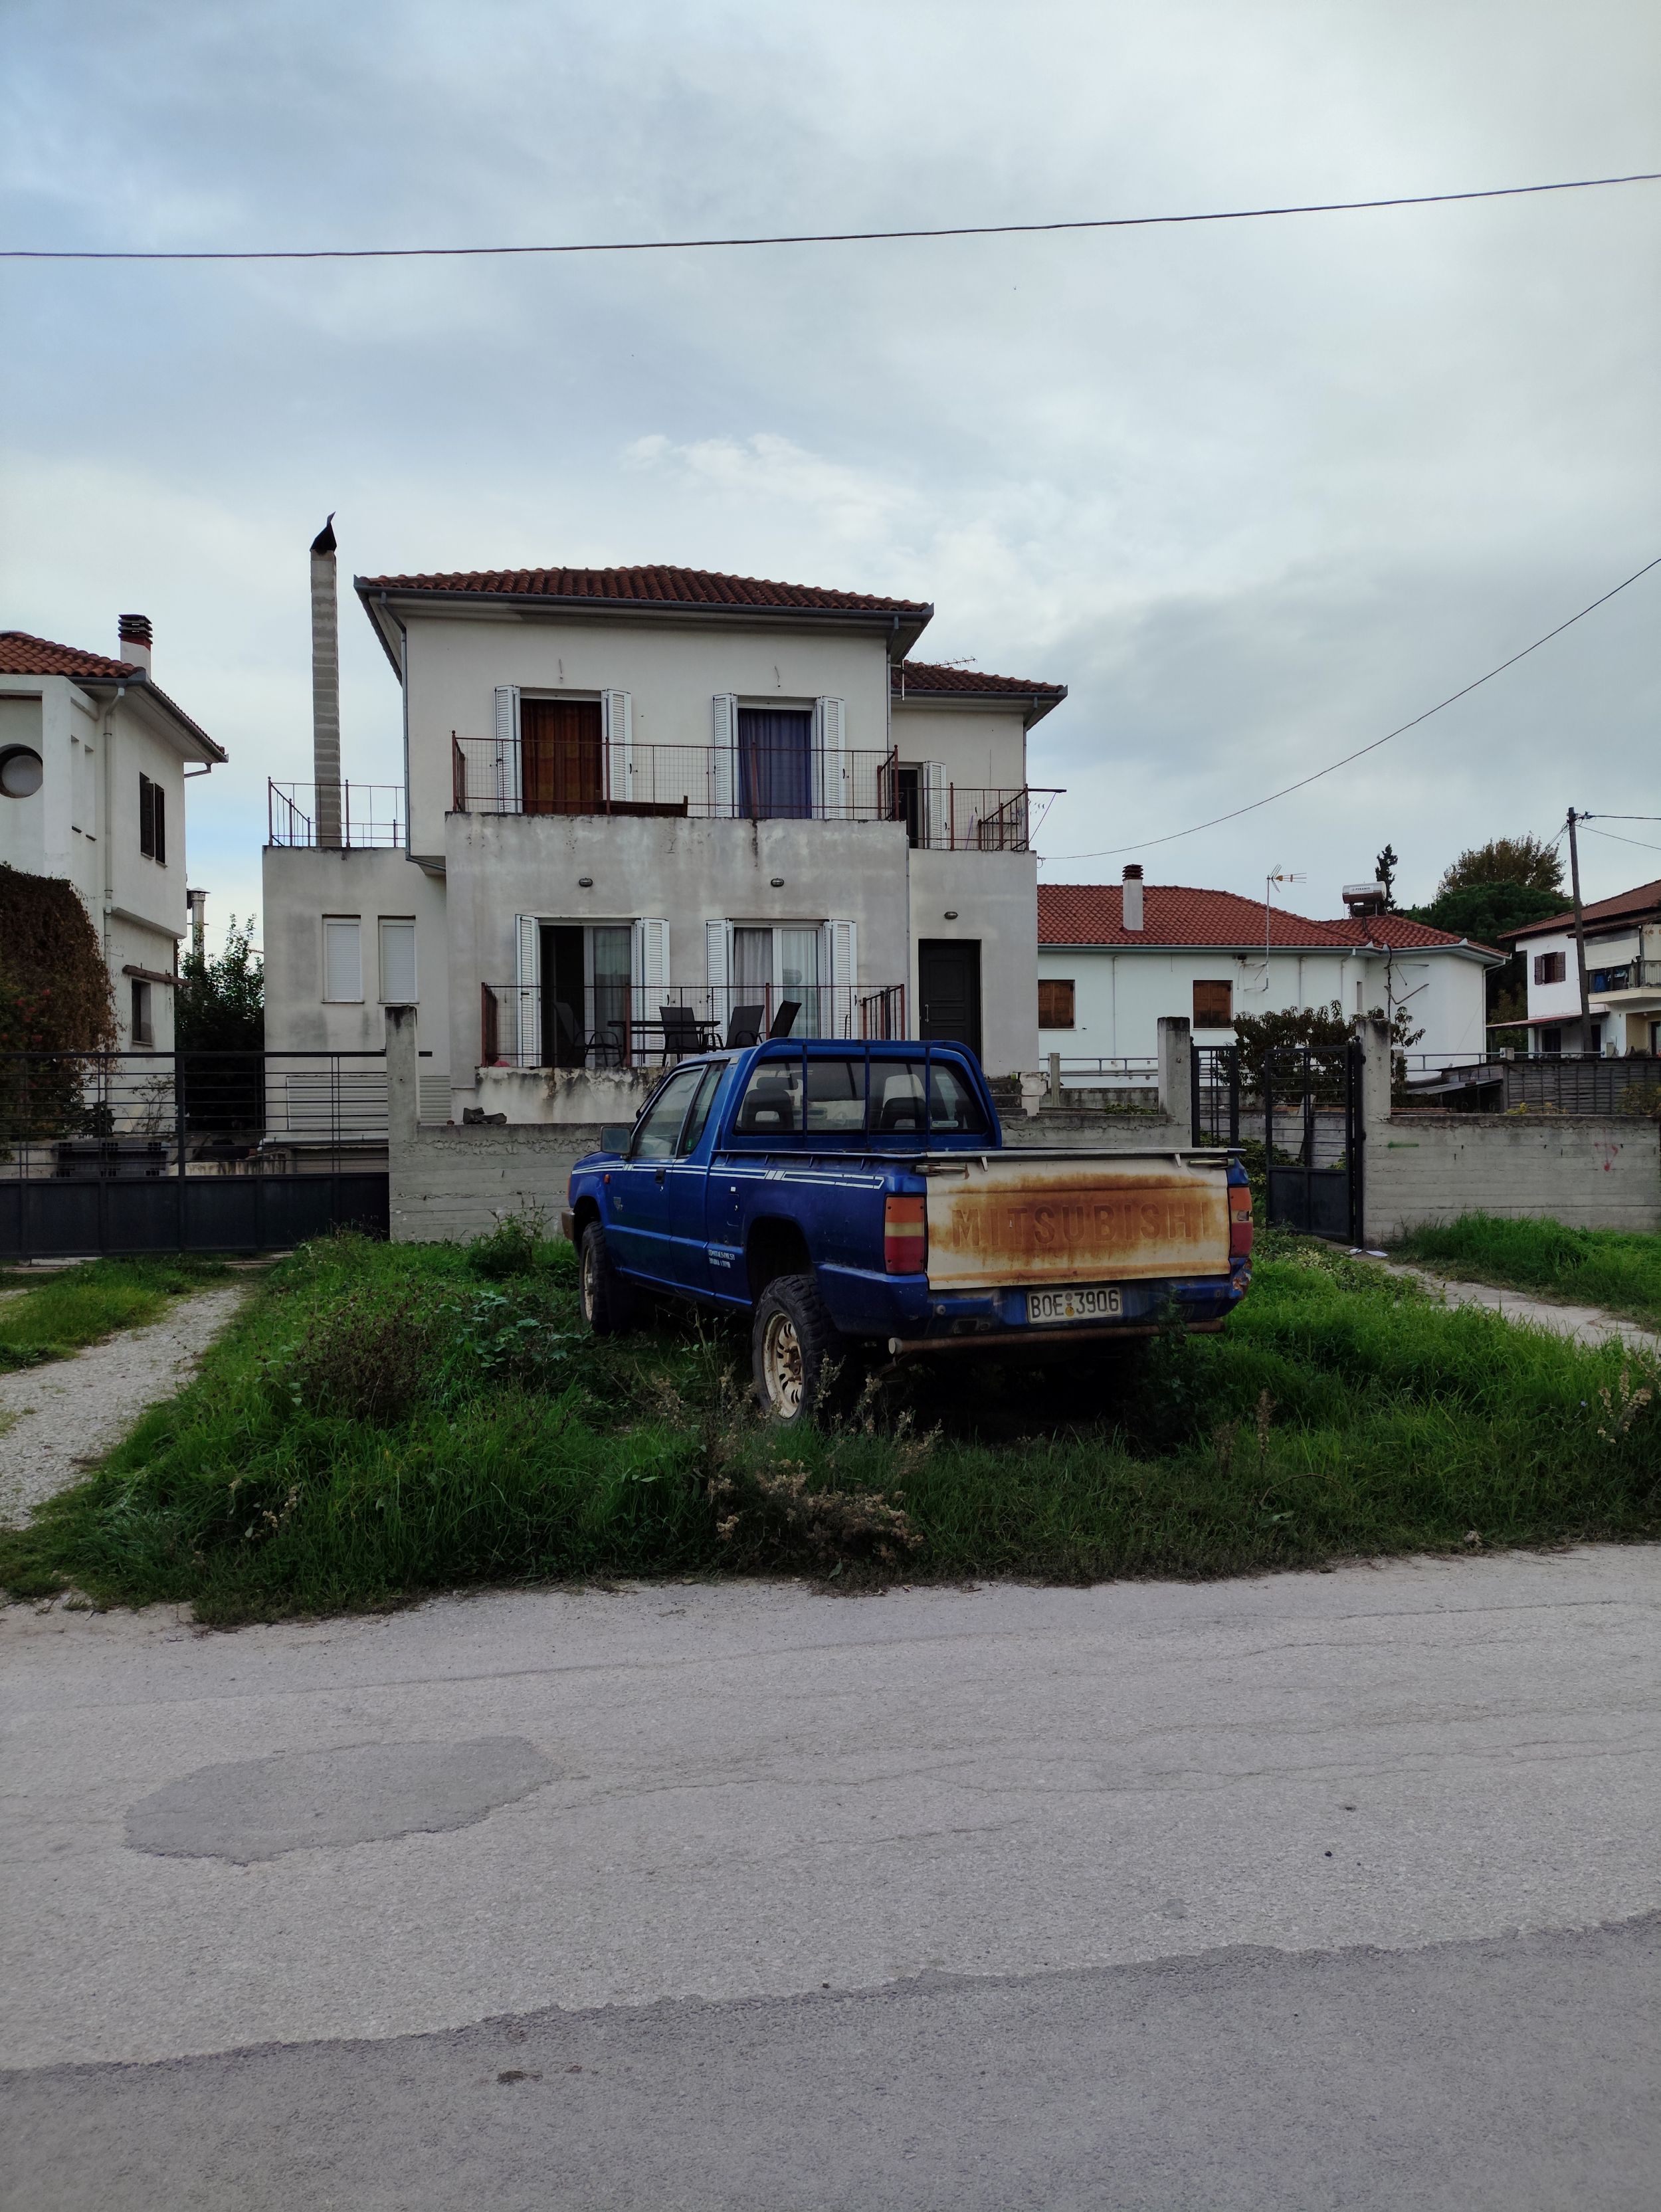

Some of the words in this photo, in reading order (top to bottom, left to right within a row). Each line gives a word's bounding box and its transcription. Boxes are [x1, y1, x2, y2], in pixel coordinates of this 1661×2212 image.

[951, 1202, 1208, 1247] MITSUBISHI
[1030, 1294, 1064, 1318] BOE
[1074, 1290, 1119, 1314] 3906
